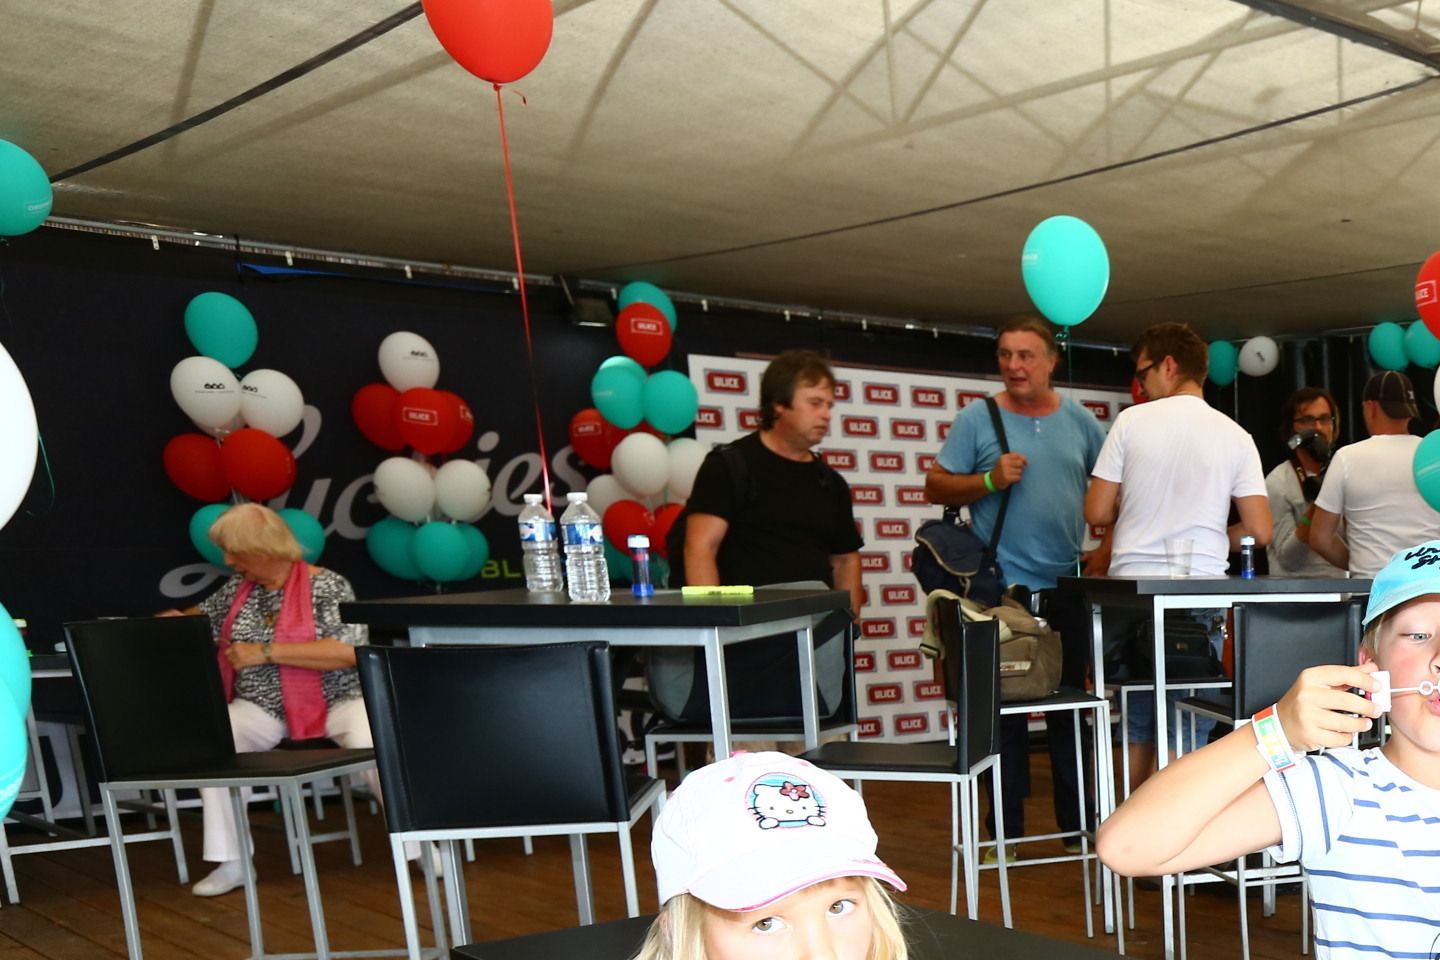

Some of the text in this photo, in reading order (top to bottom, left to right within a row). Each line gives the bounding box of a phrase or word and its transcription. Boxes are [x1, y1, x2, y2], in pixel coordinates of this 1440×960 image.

[714, 376, 739, 388] ULICE
[872, 388, 893, 400] ULICE
[918, 391, 939, 403] ULICE
[850, 422, 872, 433] ULICE
[898, 424, 920, 436] ULICE
[828, 454, 850, 466] ULICE
[877, 457, 898, 468] ULICE
[856, 490, 877, 500] ULICE
[903, 491, 925, 502] ULICE
[882, 524, 904, 535] ULICE
[889, 590, 909, 600] ULICE
[868, 623, 889, 634] ULICE
[895, 655, 916, 665] ULICE
[875, 689, 896, 699] ULICE
[922, 685, 942, 695] ULICE
[902, 719, 922, 730] ULICE
